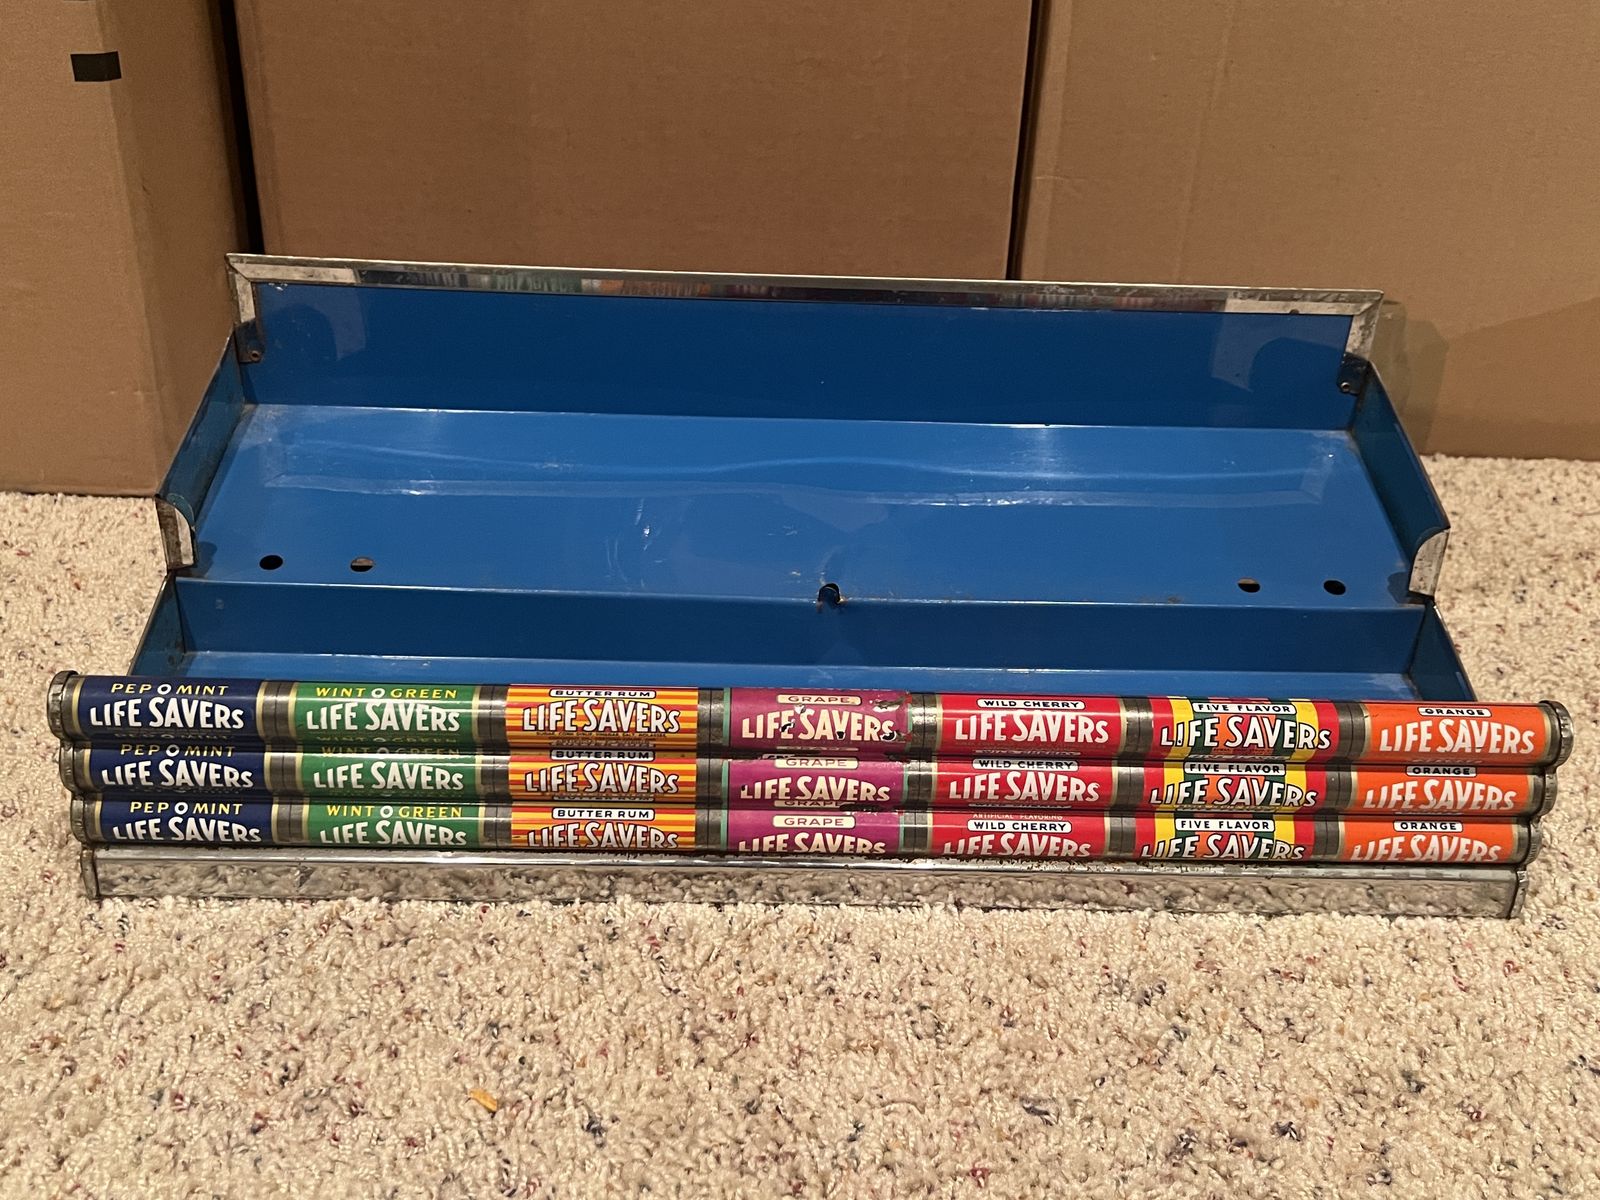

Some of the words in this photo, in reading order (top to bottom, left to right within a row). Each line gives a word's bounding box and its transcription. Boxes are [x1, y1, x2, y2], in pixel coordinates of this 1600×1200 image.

[788, 695, 850, 703] GRAPE
[1023, 700, 1079, 708] CHERRY
[1237, 704, 1291, 713] FLAVOR
[1424, 708, 1484, 716] ORANGE
[90, 698, 142, 727] LIFE
[148, 697, 244, 729] SAVERS
[306, 702, 359, 730] LIFE
[365, 701, 461, 732] SAVERS
[522, 698, 578, 732] LIFE
[583, 698, 681, 734] SAVERS
[742, 710, 794, 739] LIFE
[798, 708, 896, 741] SAVERS
[955, 712, 1007, 741] LIFE
[1011, 710, 1109, 743] SAVERS
[1160, 717, 1220, 747] LIFE
[1225, 715, 1332, 749] SAVERS
[1380, 720, 1433, 752] LIFE
[1436, 719, 1535, 754] SAVERS
[617, 751, 649, 759] RUM
[785, 758, 848, 767] GRAPE
[979, 760, 1011, 768] WILD
[1017, 761, 1074, 769] CHERRY
[1189, 764, 1220, 772] FIVE
[1228, 765, 1280, 773] FLAVOR
[101, 760, 154, 786] LIFE
[158, 759, 254, 788] SAVERS
[313, 763, 364, 789] LIFE
[370, 762, 464, 790] SAVERS
[524, 763, 579, 793] LIFE
[582, 762, 680, 794] SAVERS
[1412, 767, 1471, 775] ORANGE
[740, 777, 791, 799] LIFE
[796, 775, 890, 802] SAVERS
[949, 773, 1001, 799] LIFE
[1004, 771, 1101, 802] SAVERS
[1150, 778, 1210, 805] LIFE
[1213, 776, 1318, 808] SAVERS
[1363, 780, 1419, 809] LIFE
[1418, 779, 1517, 811] SAVERS
[557, 810, 612, 818] BUTTER
[784, 817, 844, 826] GRAPE
[974, 822, 1006, 830] WILD
[1012, 822, 1066, 831] CHERRY
[1181, 820, 1211, 829] FIVE
[1219, 821, 1270, 830] FLAVOR
[1400, 822, 1457, 830] ORANGE
[112, 818, 164, 841] LIFE
[168, 816, 262, 843] SAVERS
[320, 821, 369, 845] LIFE
[375, 820, 467, 846] SAVERS
[527, 821, 580, 848] LIFE
[584, 820, 679, 849] SAVERS
[738, 834, 790, 852] LIFE
[793, 832, 886, 854] SAVERS
[943, 834, 995, 856] LIFE
[1000, 832, 1092, 857] SAVERS
[1141, 834, 1201, 859] LIFE
[1203, 833, 1305, 860] SAVERS
[1351, 836, 1406, 862] LIFE
[1408, 834, 1502, 862] SAVERS
